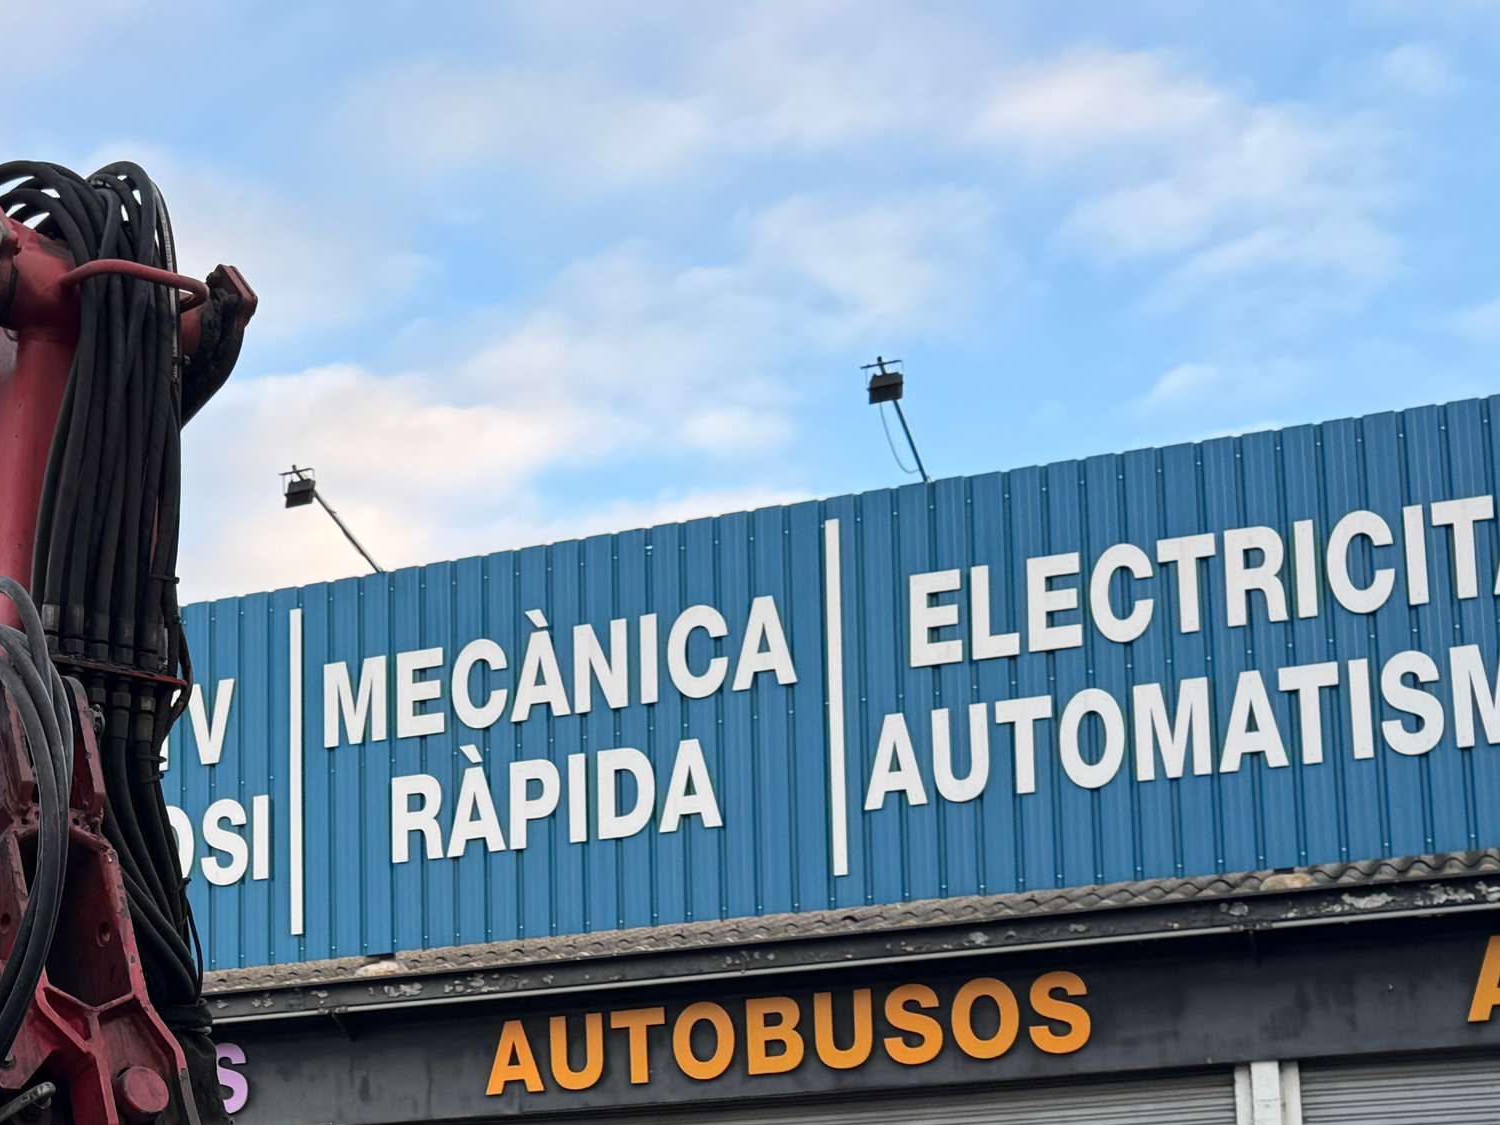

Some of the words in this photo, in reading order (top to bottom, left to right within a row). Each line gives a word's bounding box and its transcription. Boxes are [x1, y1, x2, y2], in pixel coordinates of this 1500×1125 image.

[910, 495, 1500, 667] ELECTRICIT
[159, 677, 235, 772] V
[323, 595, 798, 748] MECÀNICA
[864, 643, 1500, 811] AUTOMATISM
[391, 738, 723, 864] RÀPIDA
[486, 971, 1092, 1096] AUTOBUSOS
